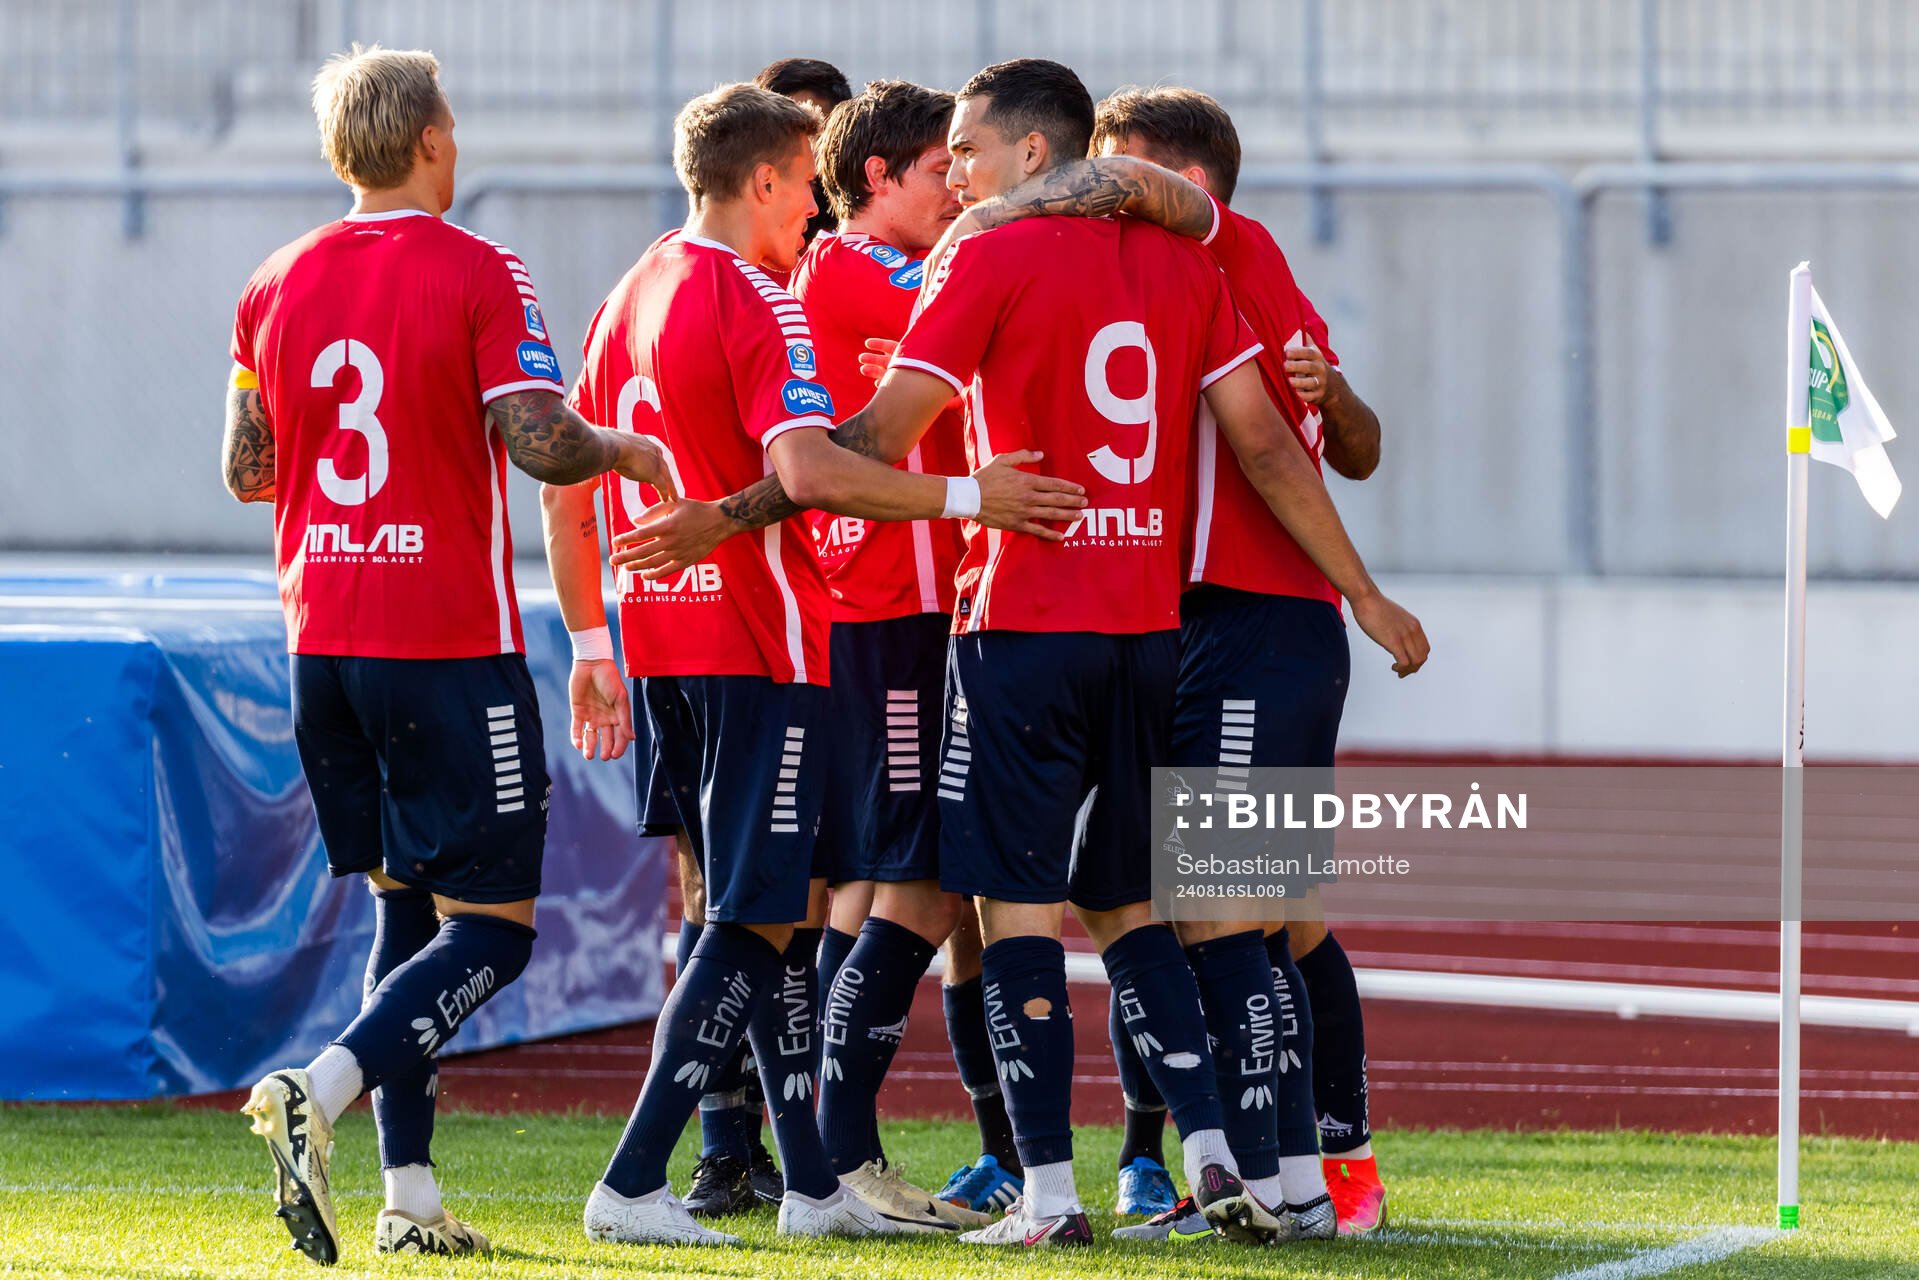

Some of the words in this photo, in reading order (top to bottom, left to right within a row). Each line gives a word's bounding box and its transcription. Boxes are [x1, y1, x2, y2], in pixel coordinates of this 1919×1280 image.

[521, 350, 555, 367] UNIBET
[787, 387, 828, 404] UNIBET
[310, 338, 389, 506] 3
[1084, 320, 1158, 485] 9
[616, 375, 686, 529] 6
[437, 965, 495, 1029] Enviro
[696, 970, 752, 1049] Envir
[821, 966, 865, 1046] Enviro
[1239, 993, 1275, 1076] Enviro
